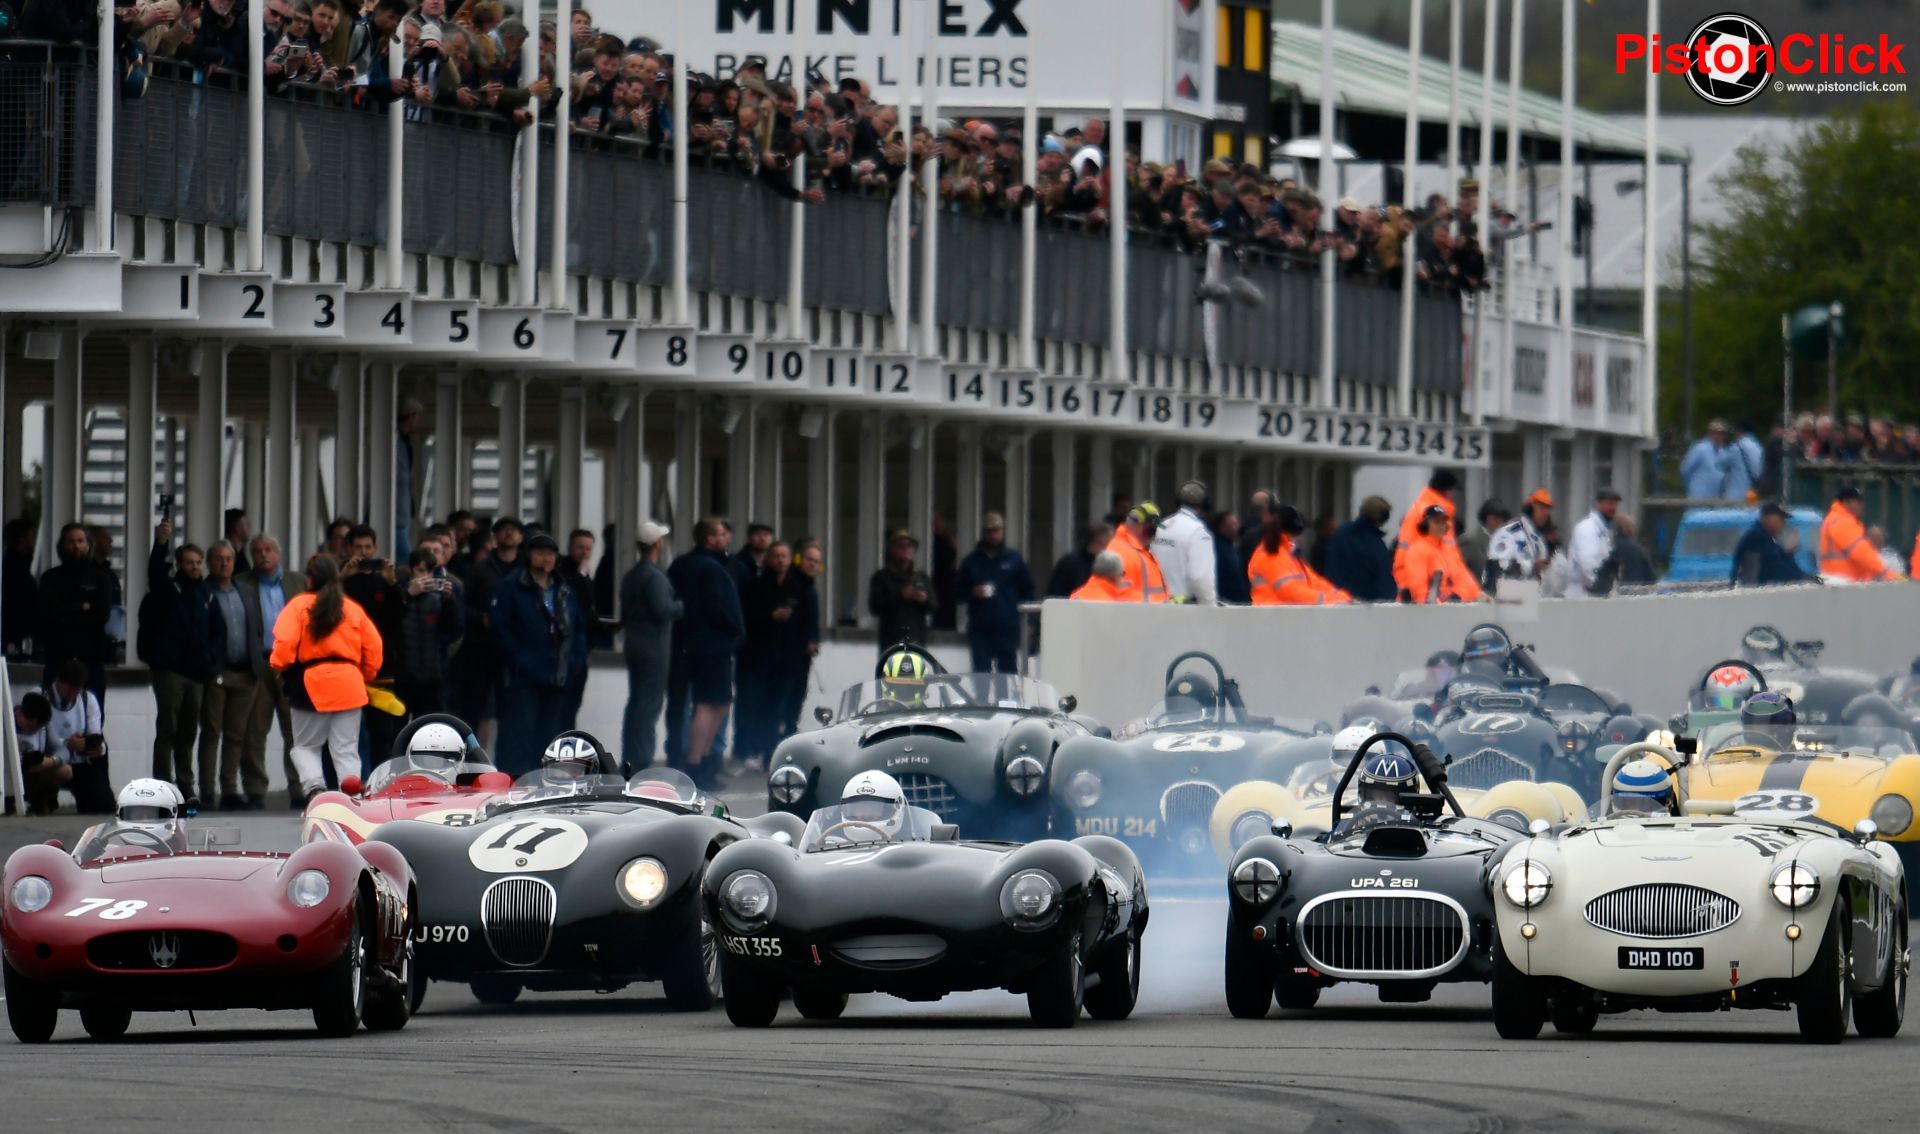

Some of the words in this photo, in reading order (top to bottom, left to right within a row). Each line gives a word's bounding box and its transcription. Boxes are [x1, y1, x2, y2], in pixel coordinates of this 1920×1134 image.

[715, 0, 1028, 37] MNEX
[877, 56, 1027, 88] LNERS
[180, 275, 189, 310] 1
[242, 284, 265, 319] 2
[313, 294, 335, 328] 3
[381, 302, 404, 335] 4
[448, 310, 469, 343] 5
[513, 318, 535, 350] 6
[606, 329, 627, 359] 7
[667, 336, 687, 367] 8
[728, 344, 748, 374] 9
[765, 351, 805, 381] 10
[827, 357, 857, 387] 11
[874, 364, 909, 393] 12
[950, 373, 983, 401] 14
[1001, 380, 1034, 407] 15
[1046, 386, 1080, 413] 16
[1093, 390, 1125, 417] 17
[1138, 396, 1172, 422] 18
[1183, 402, 1216, 427] 19
[1258, 411, 1293, 437] 20
[1302, 418, 1333, 443] 21
[1338, 422, 1372, 446] 22
[1380, 427, 1410, 452] 23
[1415, 430, 1444, 455] 24
[1452, 435, 1482, 460] 25
[1737, 795, 1815, 811] 28
[486, 821, 568, 855] 11
[1075, 817, 1119, 836] MDU
[1124, 819, 1157, 838] 214
[1351, 878, 1385, 888] UPA
[1389, 878, 1419, 889] 261
[64, 898, 148, 920] 78
[432, 925, 469, 942] 970
[723, 935, 750, 956] HST
[751, 937, 782, 957] 355
[583, 943, 599, 952] TOW
[1628, 951, 1661, 967] DHD
[1667, 951, 1694, 967] 100
